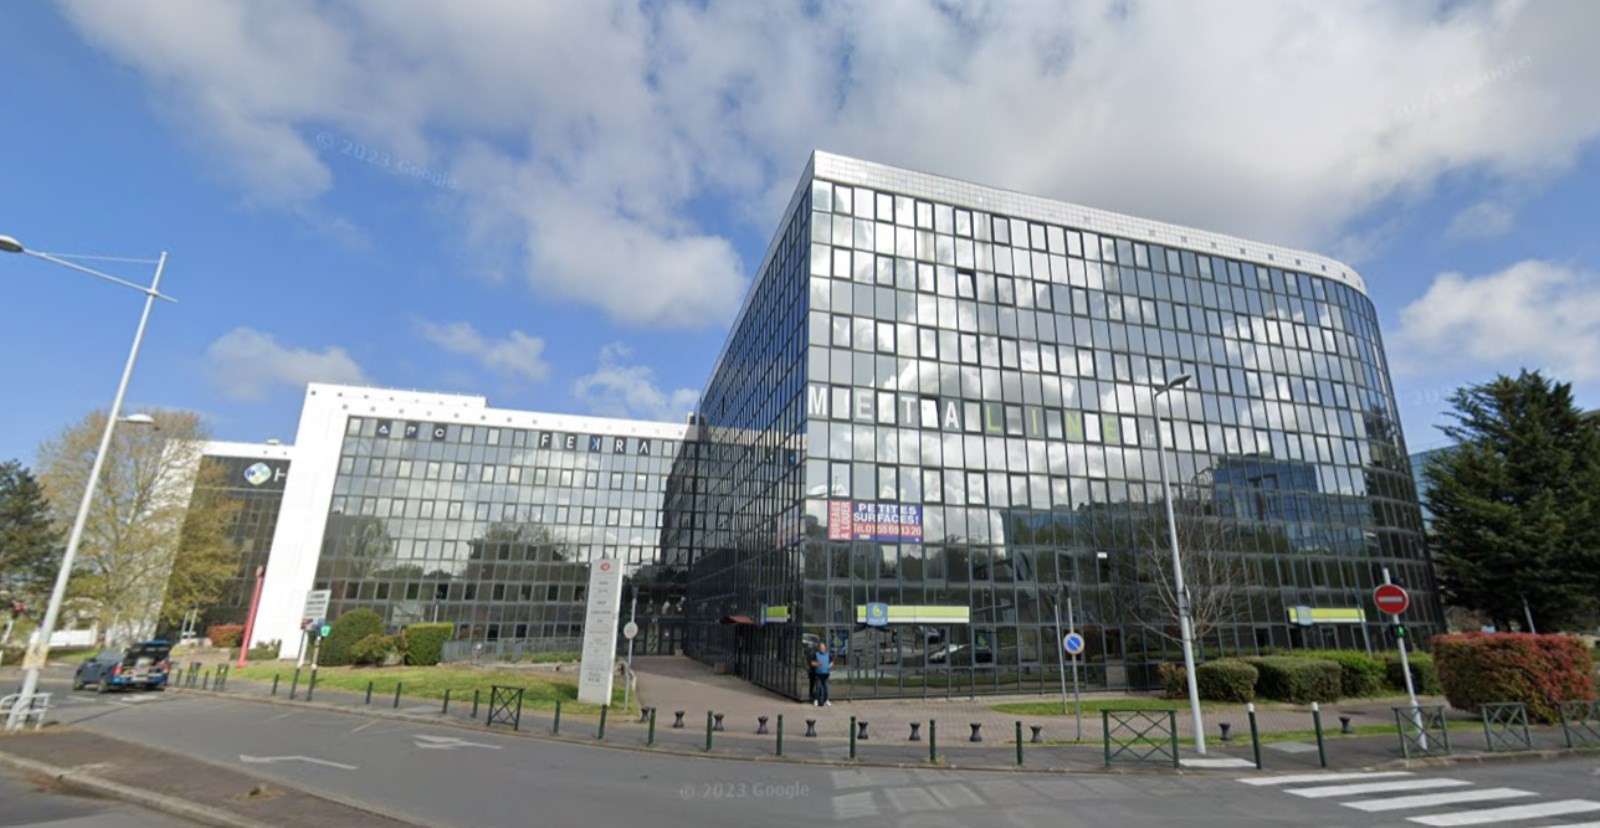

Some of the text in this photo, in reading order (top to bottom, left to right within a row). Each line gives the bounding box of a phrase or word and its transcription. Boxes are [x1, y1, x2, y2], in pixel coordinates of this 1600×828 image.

[808, 385, 1121, 443] METALINE
[858, 503, 917, 516] PETITES
[853, 512, 920, 525] SURFACES!
